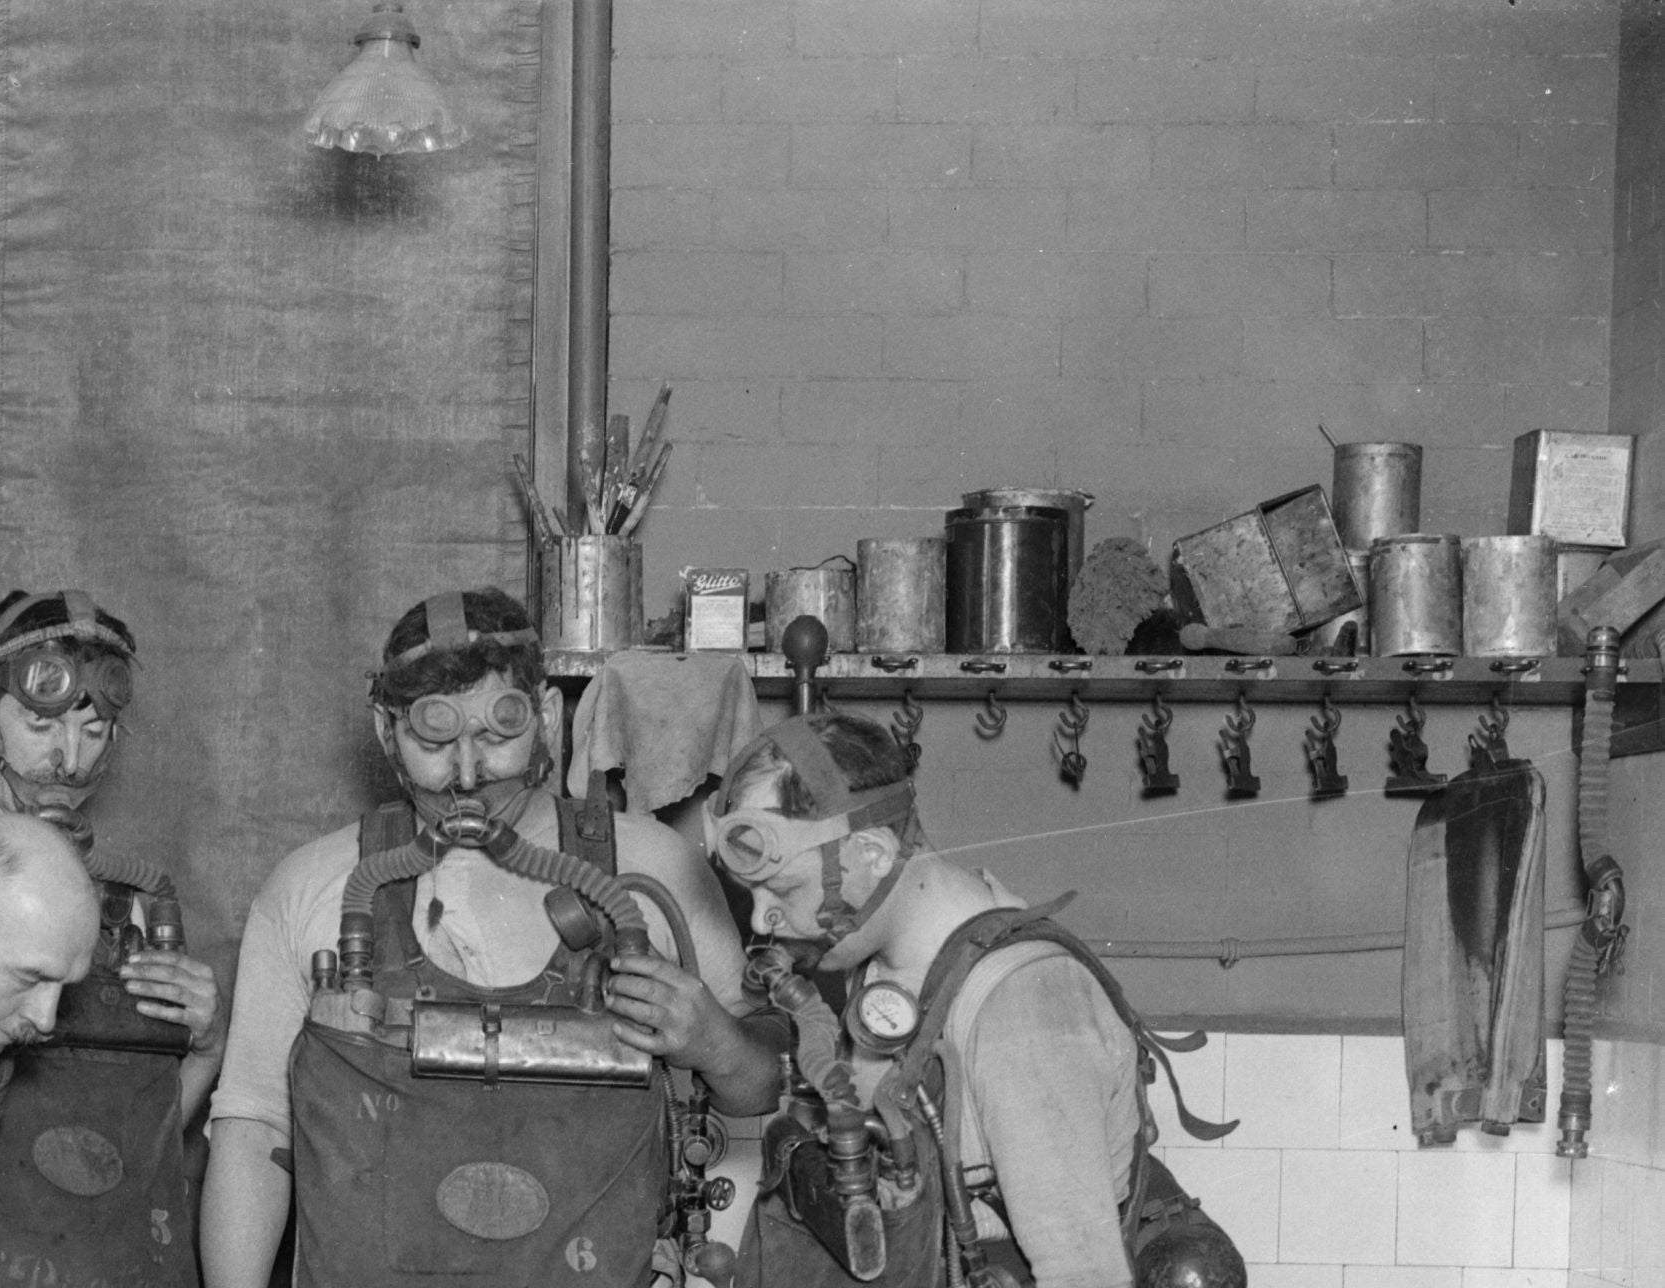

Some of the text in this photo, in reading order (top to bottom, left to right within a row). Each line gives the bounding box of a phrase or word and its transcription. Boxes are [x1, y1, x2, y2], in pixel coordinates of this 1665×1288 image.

[693, 574, 740, 592] Glitto
[150, 1208, 173, 1245] 5
[565, 1236, 597, 1273] 6
